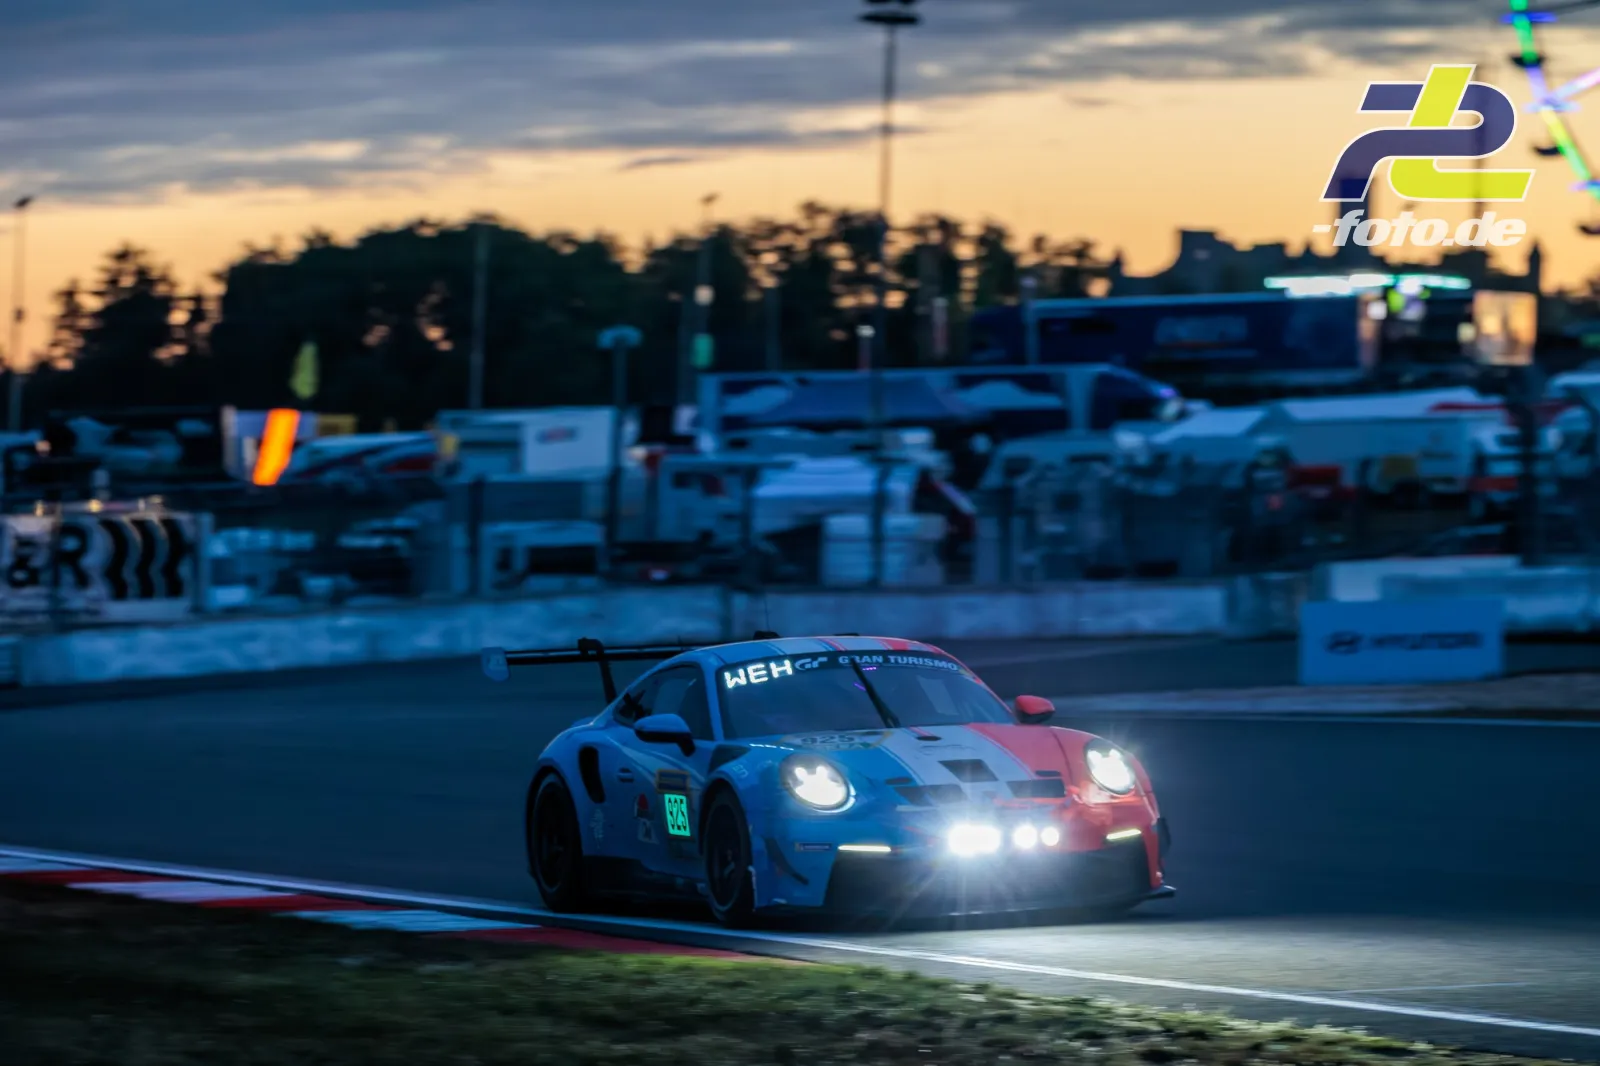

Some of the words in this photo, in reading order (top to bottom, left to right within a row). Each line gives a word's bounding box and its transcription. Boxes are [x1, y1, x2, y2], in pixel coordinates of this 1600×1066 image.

[724, 659, 793, 690] WEH
[838, 655, 884, 666] GRAN
[888, 655, 959, 671] TURISMO
[668, 797, 686, 831] 925
